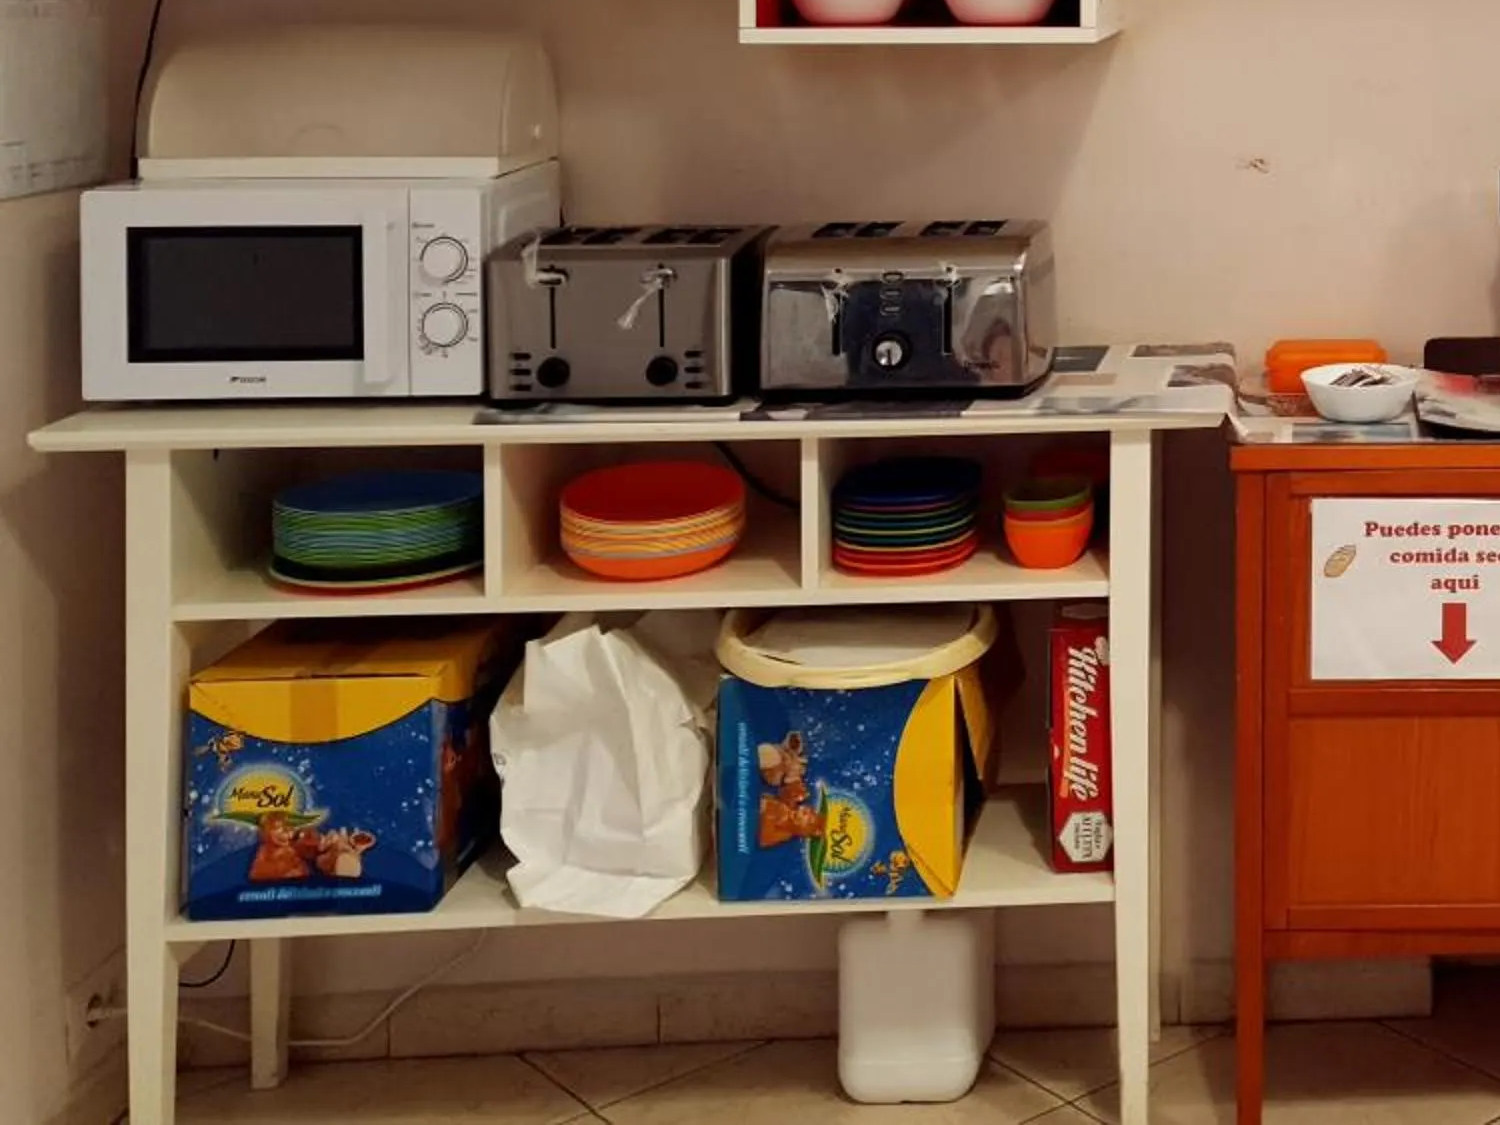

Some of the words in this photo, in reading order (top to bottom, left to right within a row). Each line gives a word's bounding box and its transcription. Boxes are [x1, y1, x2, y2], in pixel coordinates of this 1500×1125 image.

[1364, 521, 1441, 537] Puedes
[1389, 547, 1469, 565] comida
[1066, 646, 1100, 755] Kitchen
[1064, 756, 1099, 801] life
